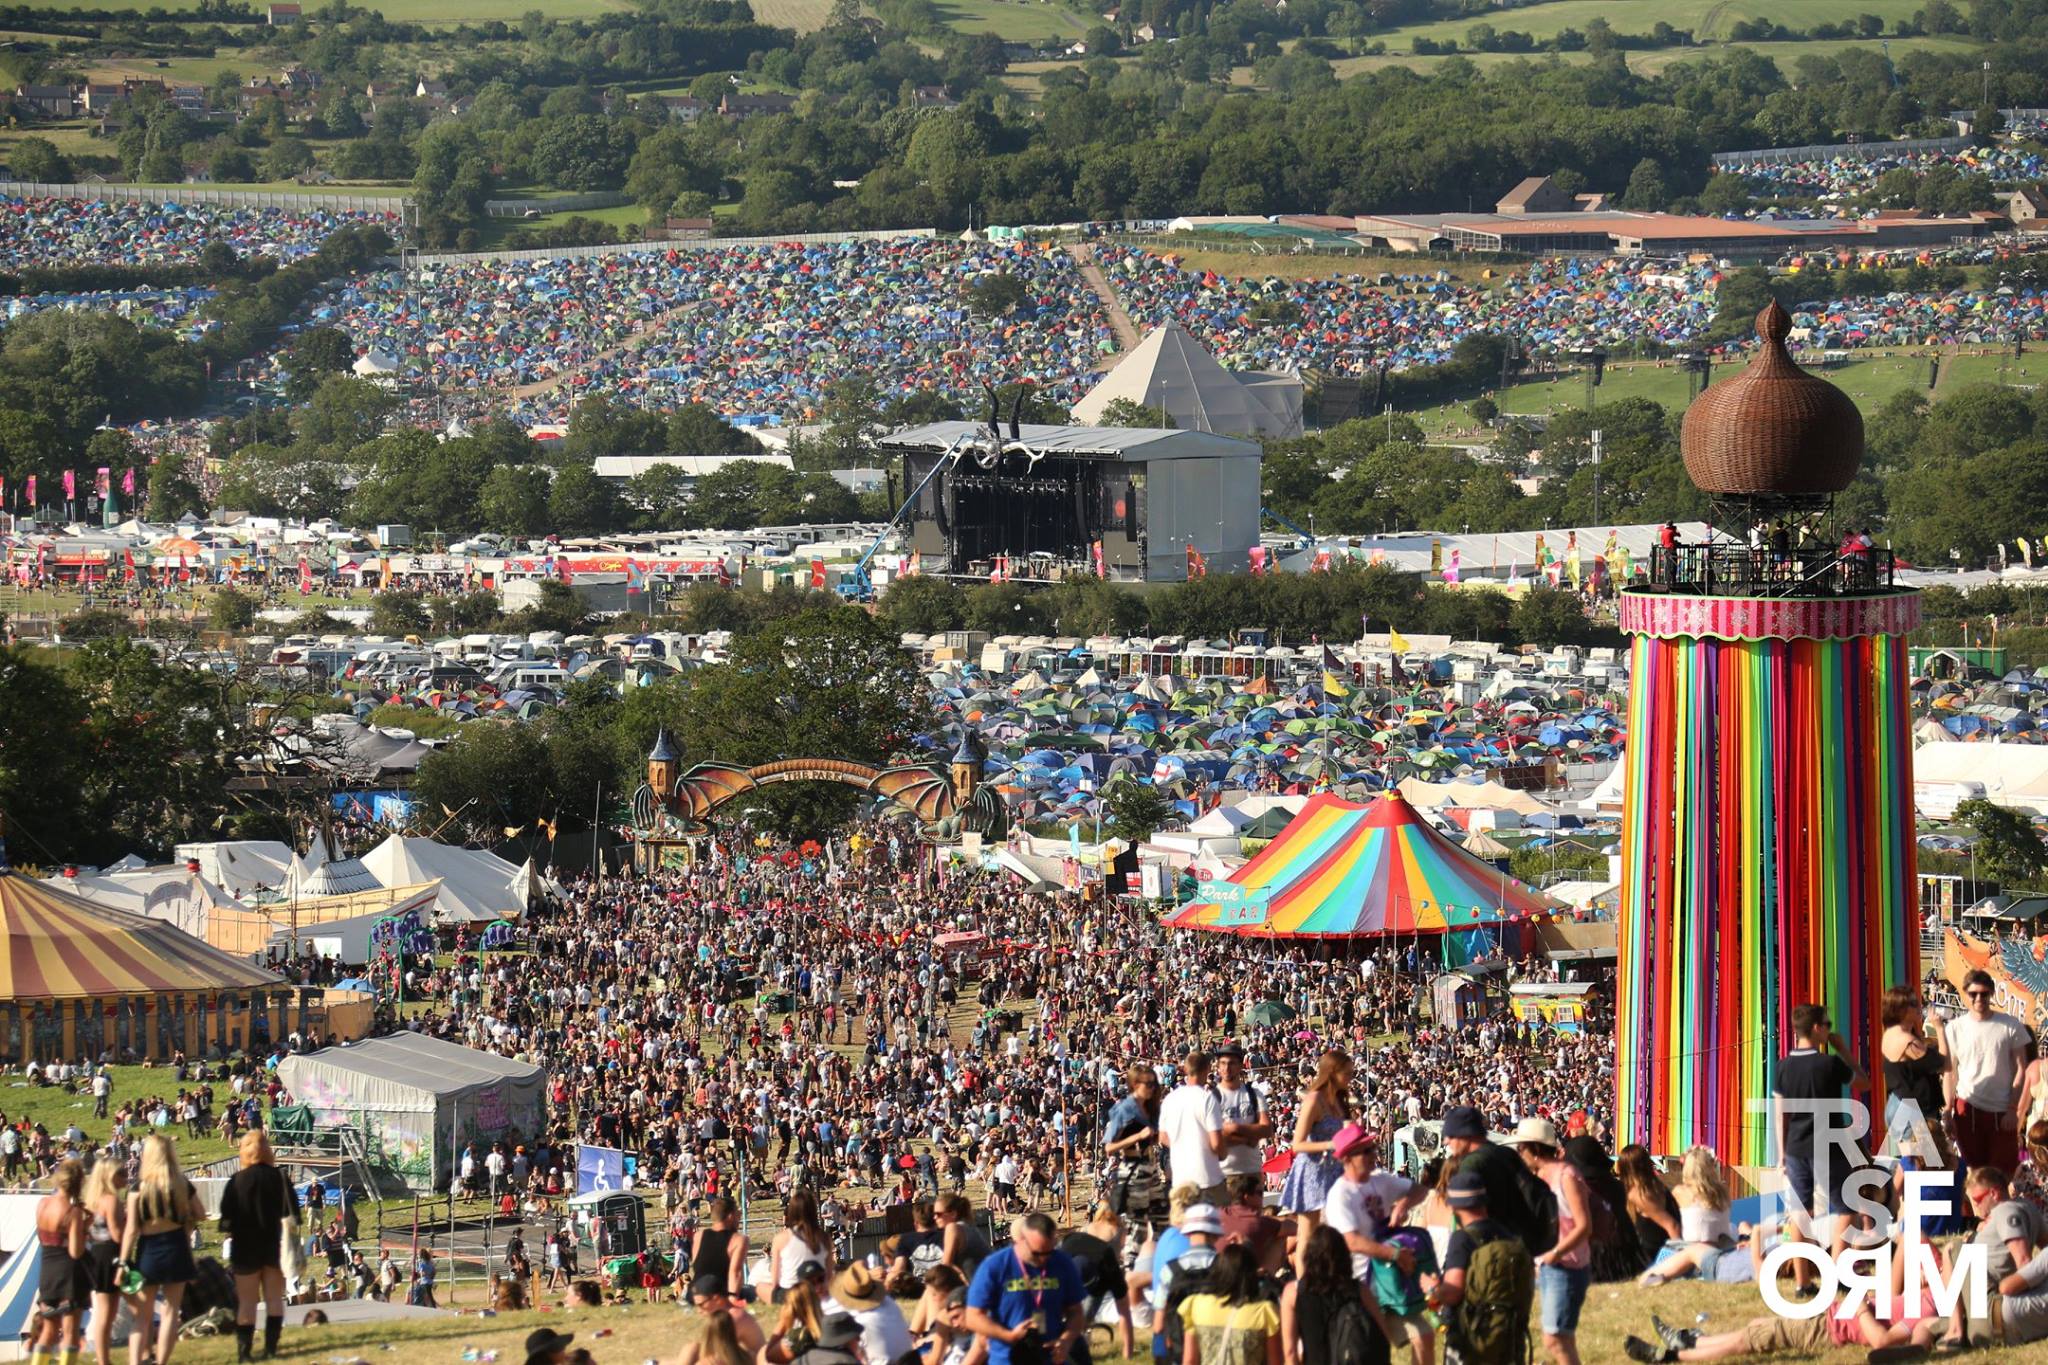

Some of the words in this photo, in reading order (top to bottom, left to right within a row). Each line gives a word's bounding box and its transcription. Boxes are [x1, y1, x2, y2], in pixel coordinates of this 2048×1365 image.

[785, 770, 809, 781] THE
[812, 770, 840, 781] PARK
[1201, 884, 1240, 902] Park
